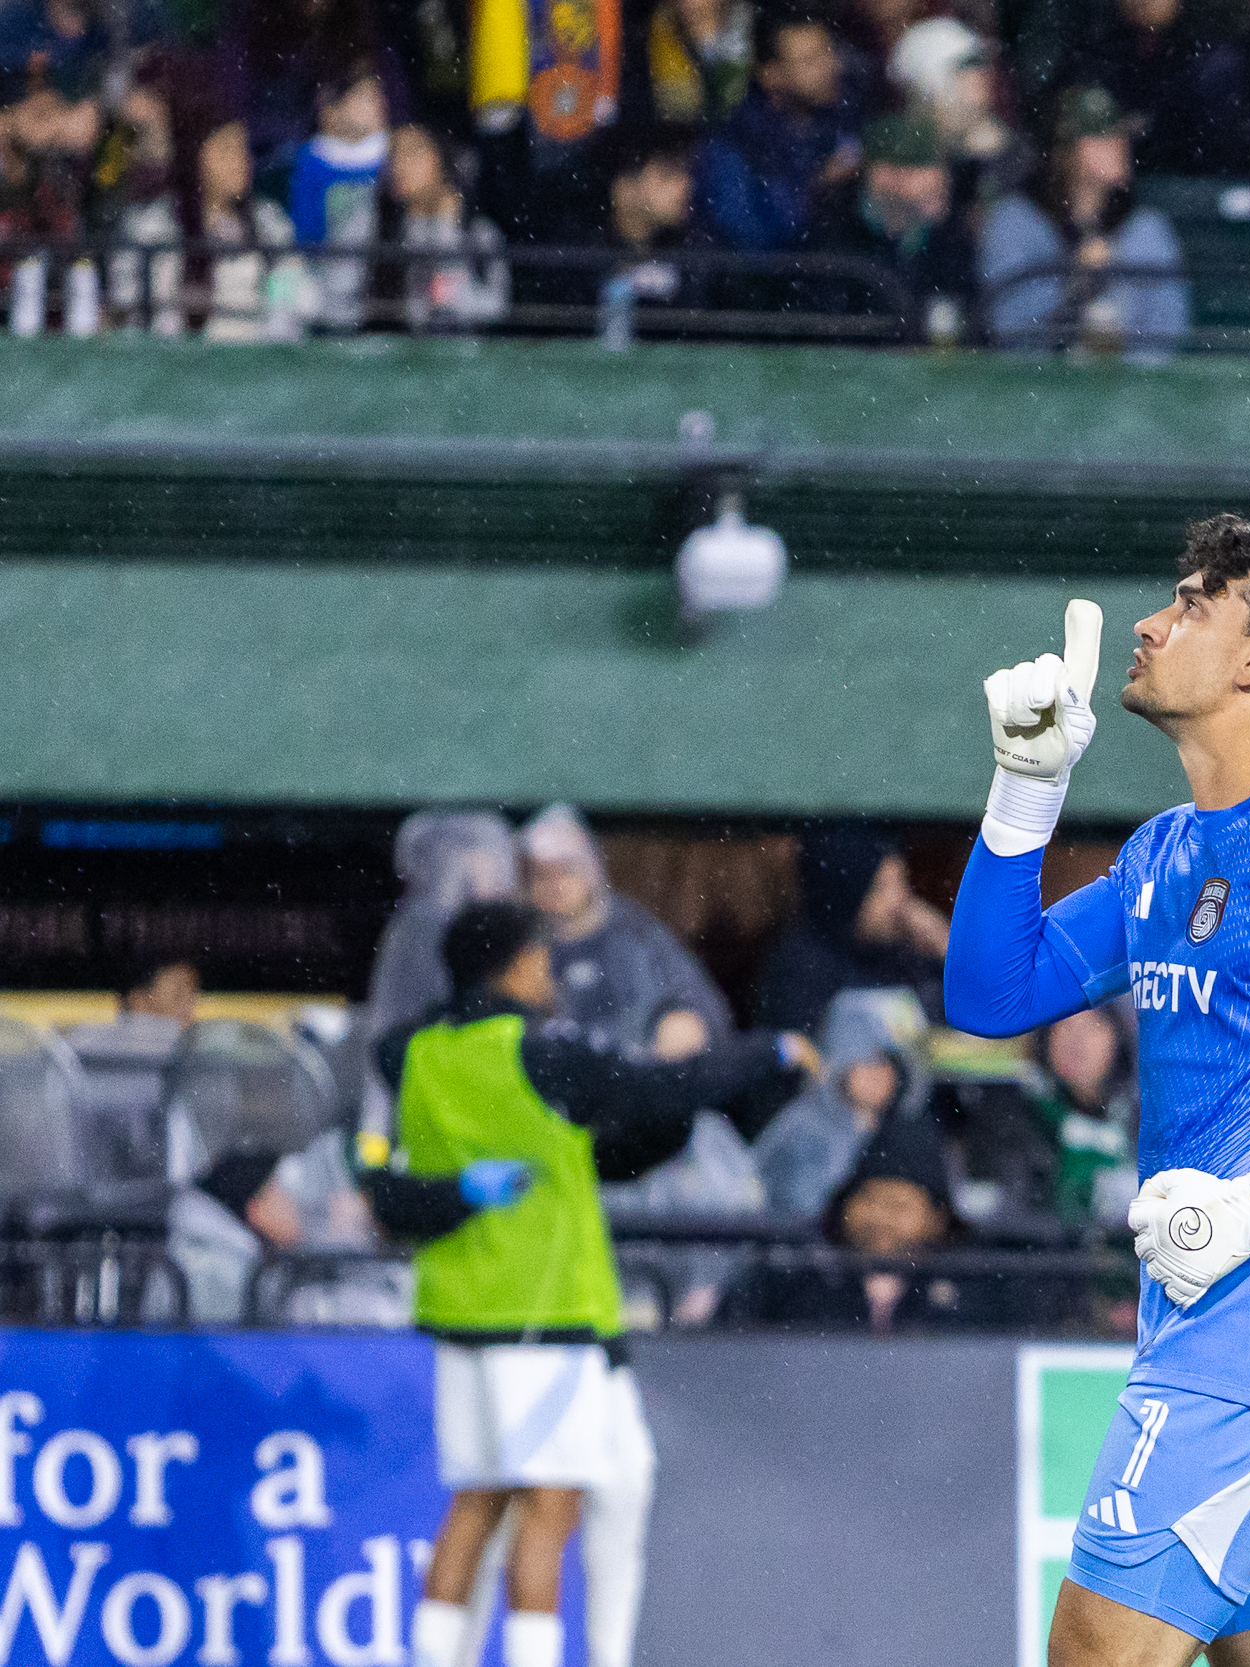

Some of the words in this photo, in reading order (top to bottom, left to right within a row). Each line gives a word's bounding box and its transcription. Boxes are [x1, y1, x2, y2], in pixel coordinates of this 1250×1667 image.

[994, 745, 1010, 756] EST
[1012, 753, 1041, 766] COAST
[1130, 961, 1217, 1015] RECTV
[0, 1390, 199, 1530] for
[250, 1429, 335, 1530] a
[1121, 1398, 1170, 1488] 1
